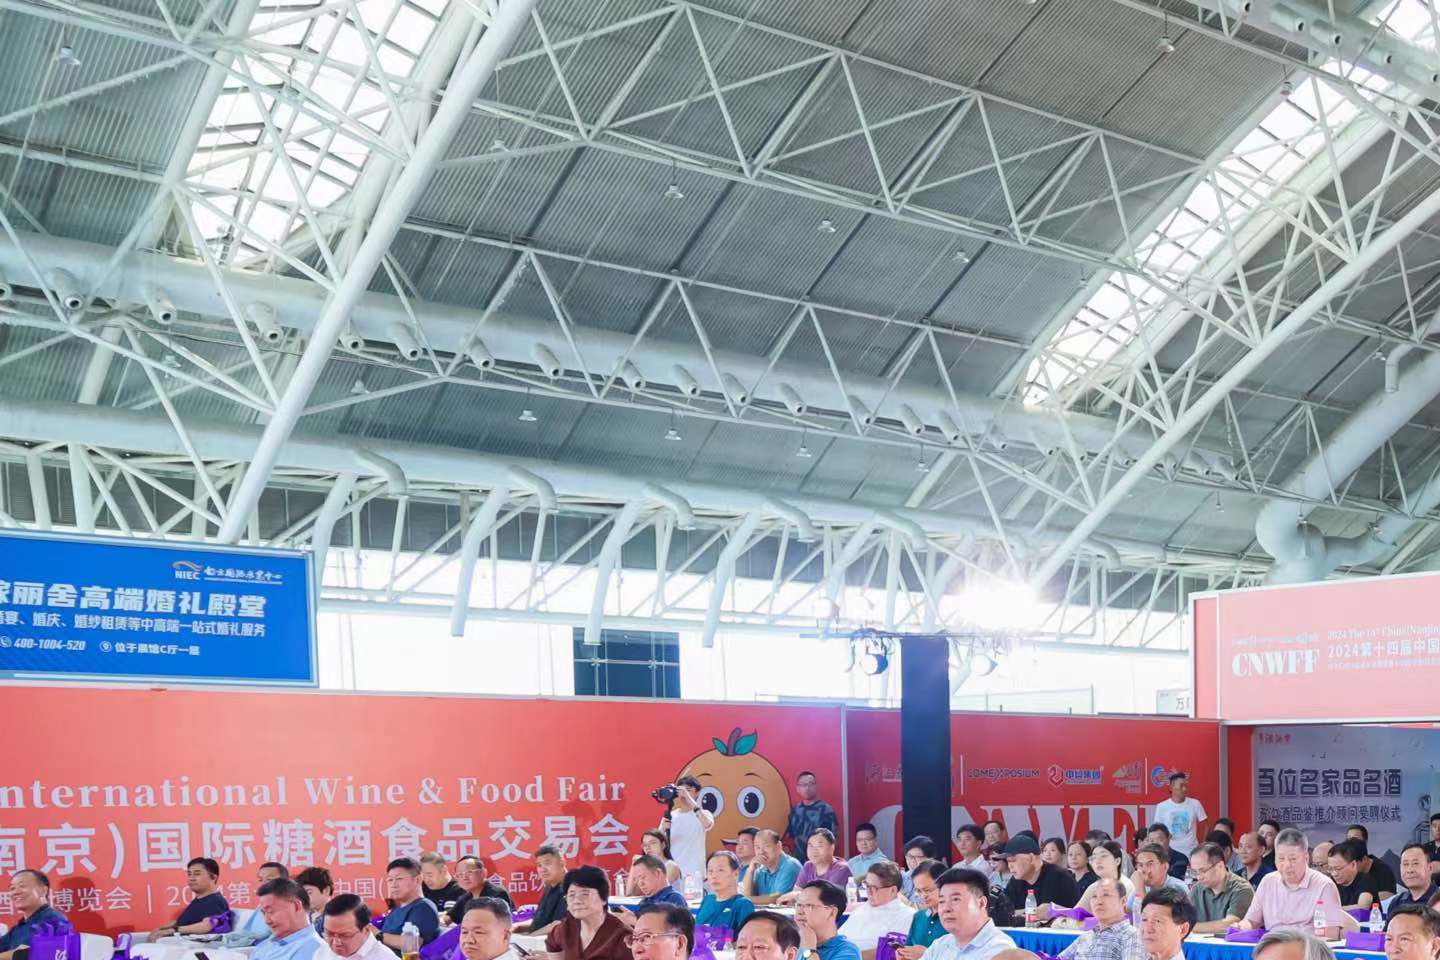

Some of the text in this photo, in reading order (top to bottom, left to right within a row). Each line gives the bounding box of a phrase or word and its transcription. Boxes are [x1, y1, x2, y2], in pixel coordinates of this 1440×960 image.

[175, 570, 200, 580] NIEC
[1232, 649, 1320, 677] CNWFF
[304, 776, 405, 805] Wine
[418, 777, 444, 805] &
[458, 774, 544, 803] Food
[557, 774, 626, 802] Fair
[1258, 768, 1402, 796] 百位名家品名酒
